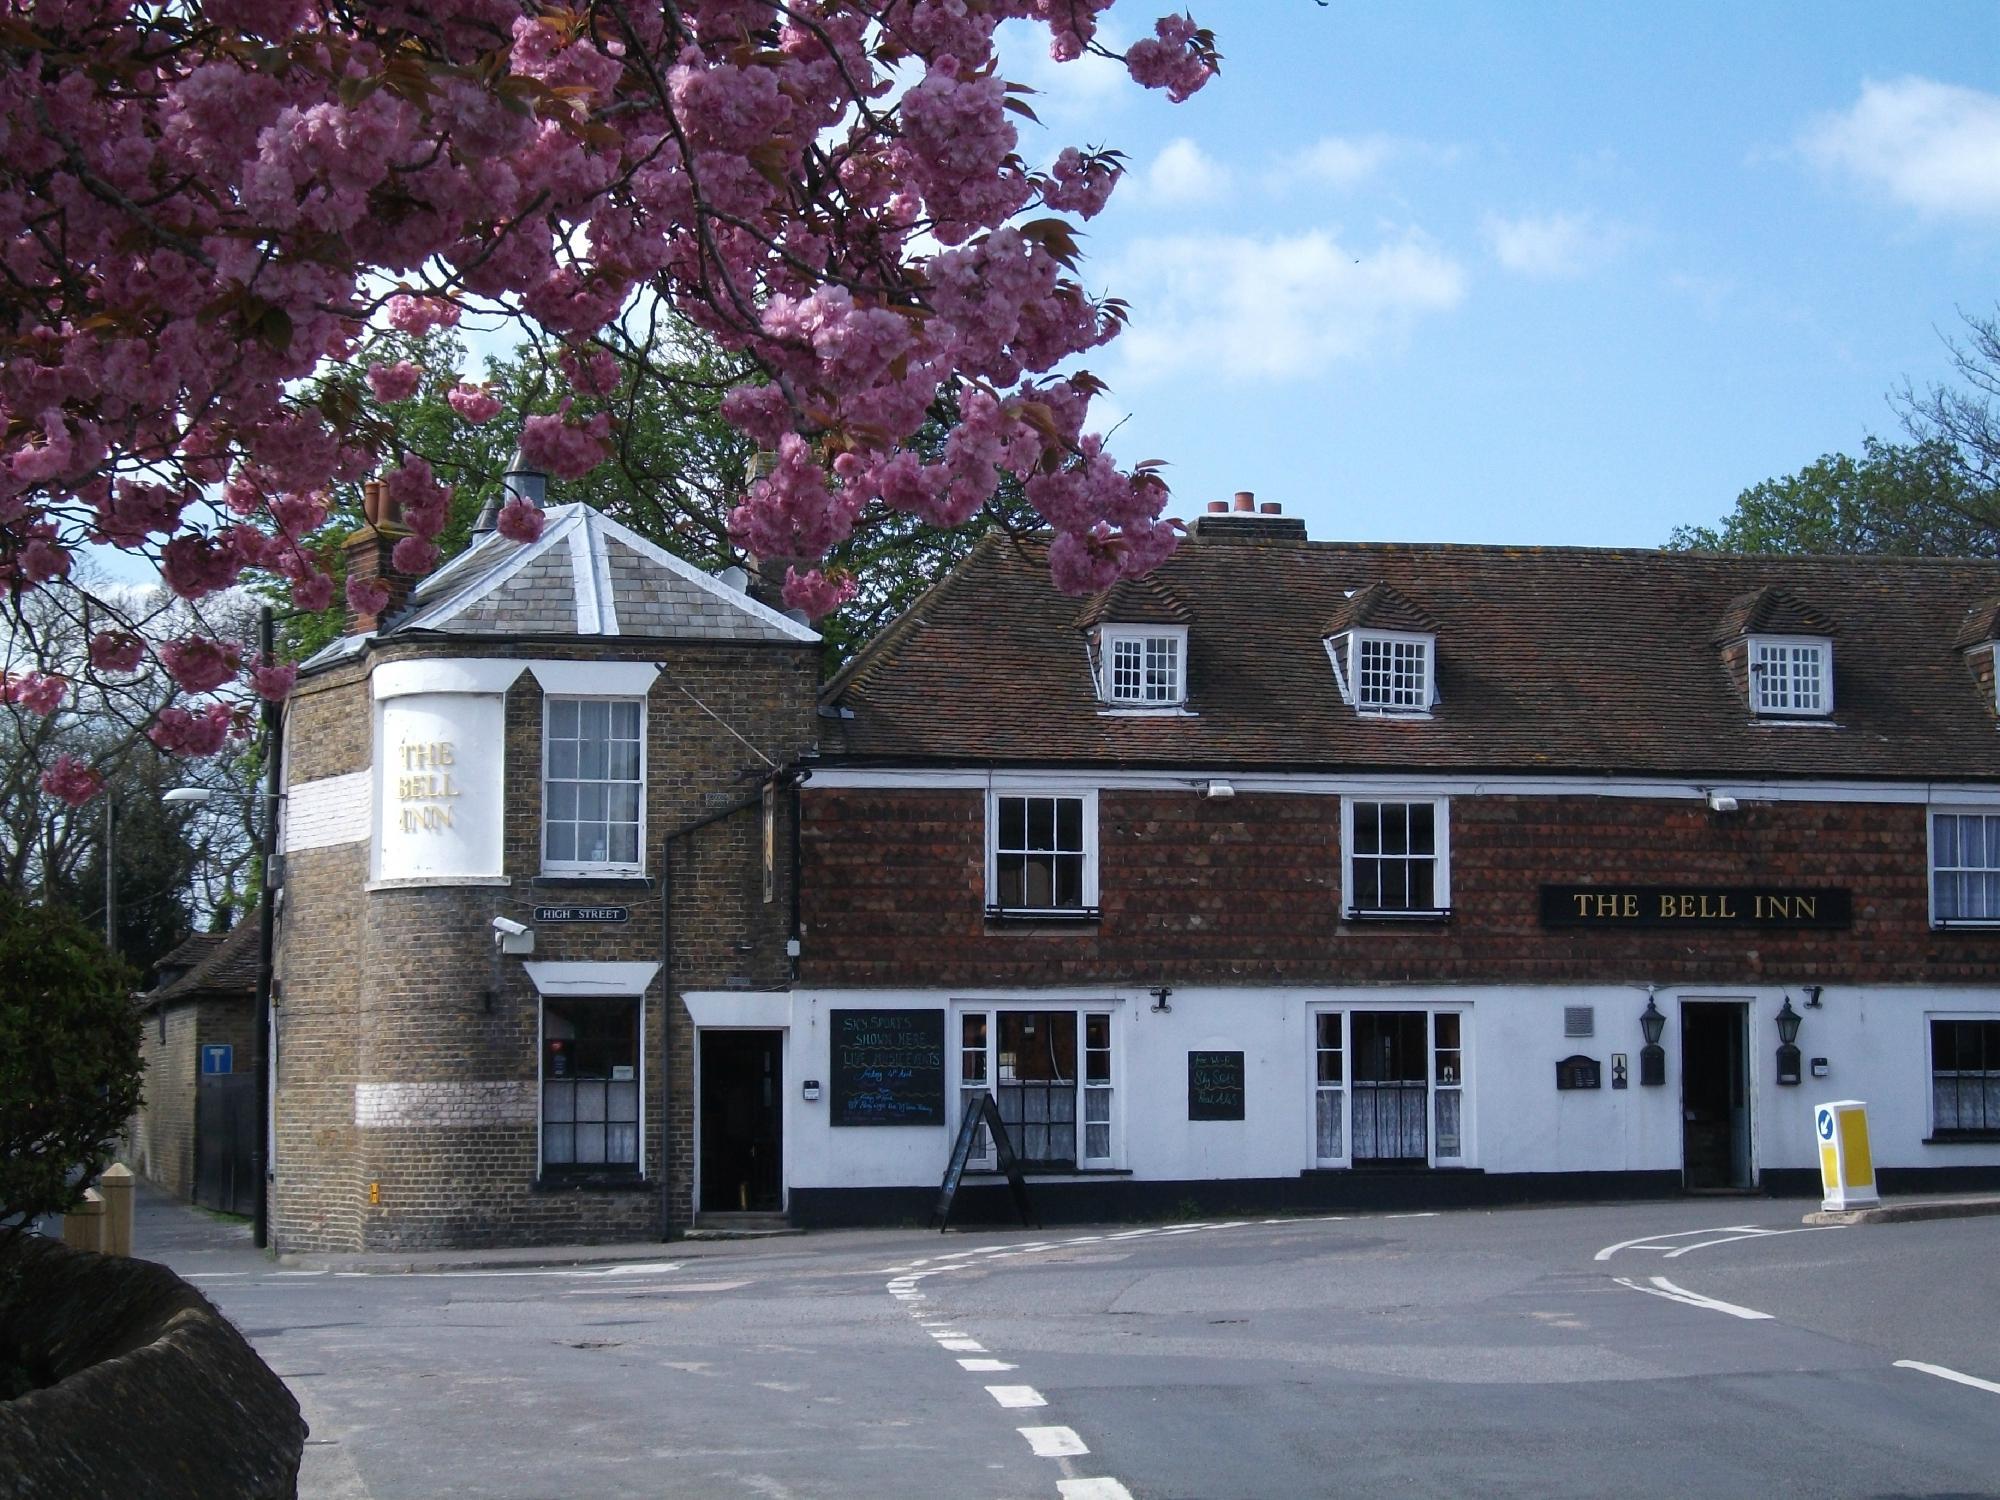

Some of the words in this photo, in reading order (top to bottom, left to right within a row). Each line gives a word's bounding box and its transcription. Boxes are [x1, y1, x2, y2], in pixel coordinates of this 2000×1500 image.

[399, 741, 455, 767] THE
[397, 773, 459, 799] BELL
[399, 804, 454, 832] INN
[543, 909, 570, 919] HIGH
[578, 909, 620, 919] STREET
[1573, 894, 1639, 917] THE
[1659, 895, 1736, 918] BELL
[1753, 895, 1816, 919] INN
